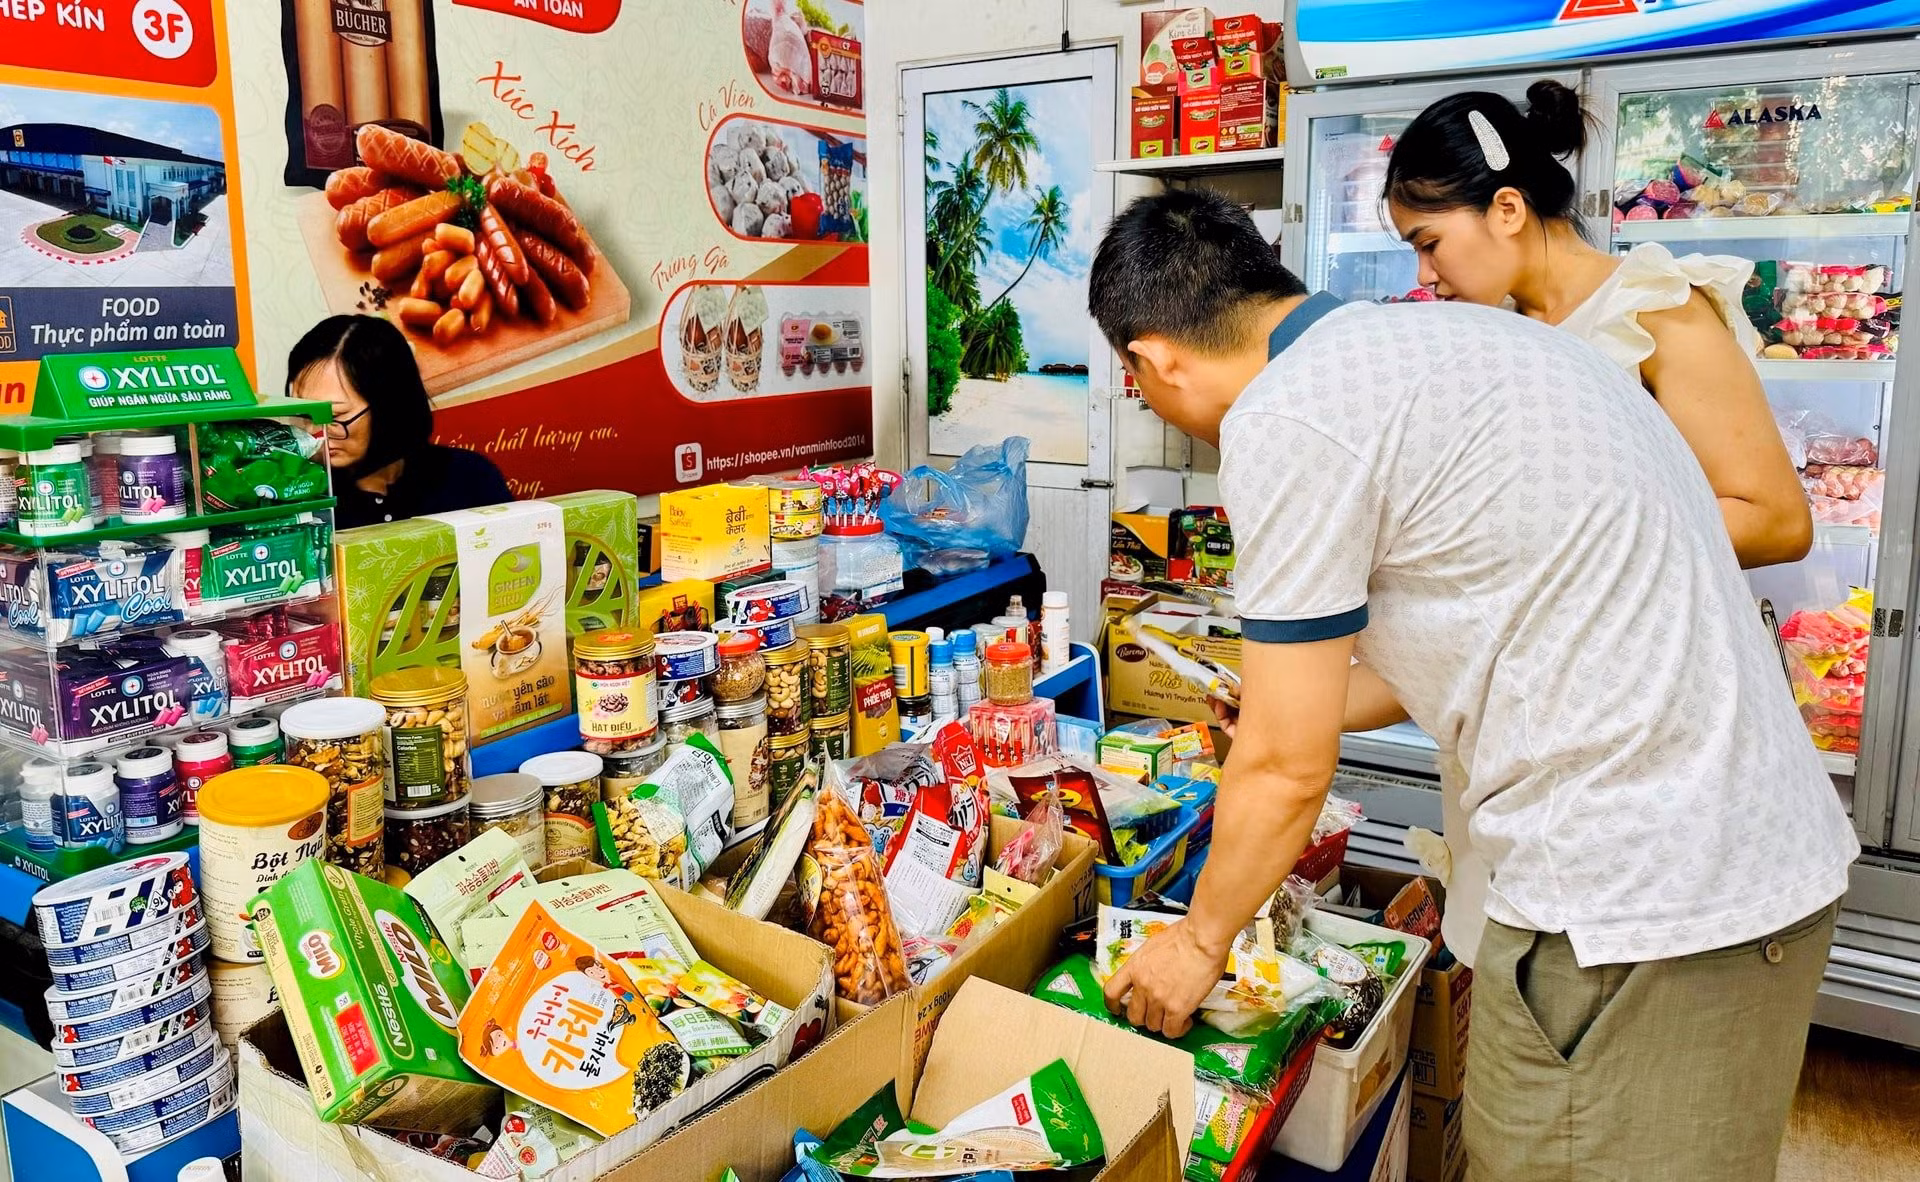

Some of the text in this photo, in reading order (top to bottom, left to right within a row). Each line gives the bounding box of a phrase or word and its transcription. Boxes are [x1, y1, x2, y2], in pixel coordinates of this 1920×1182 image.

[57, 0, 105, 31] KÍN
[143, 9, 183, 43] 3F
[1726, 102, 1823, 126] ALASKA
[101, 297, 161, 317] FOOD
[31, 319, 226, 347] Thực phẩm an toàn
[112, 364, 227, 390] XYLITOL
[89, 396, 115, 408] GIÚP
[18, 494, 83, 512] XYLITOL
[118, 485, 163, 499] YLITOL
[226, 552, 249, 560] LOTTE
[70, 575, 96, 583] LOTTE
[224, 558, 302, 588] XYLITOL
[494, 576, 535, 593] GREEN
[71, 574, 165, 606] XYLITOL
[8, 600, 39, 628] Cool
[121, 587, 173, 623] Cool
[253, 652, 276, 661] LOTTE
[252, 654, 328, 688] XYLITOL
[90, 688, 117, 699] LOTTE
[193, 676, 228, 696] XYLIT
[90, 689, 181, 728] XYLITOL
[80, 810, 124, 836] XYLIT
[22, 859, 50, 881] XYLITOL
[251, 850, 289, 874] Bột
[306, 932, 336, 974] MILO
[389, 917, 452, 1022] MILO
